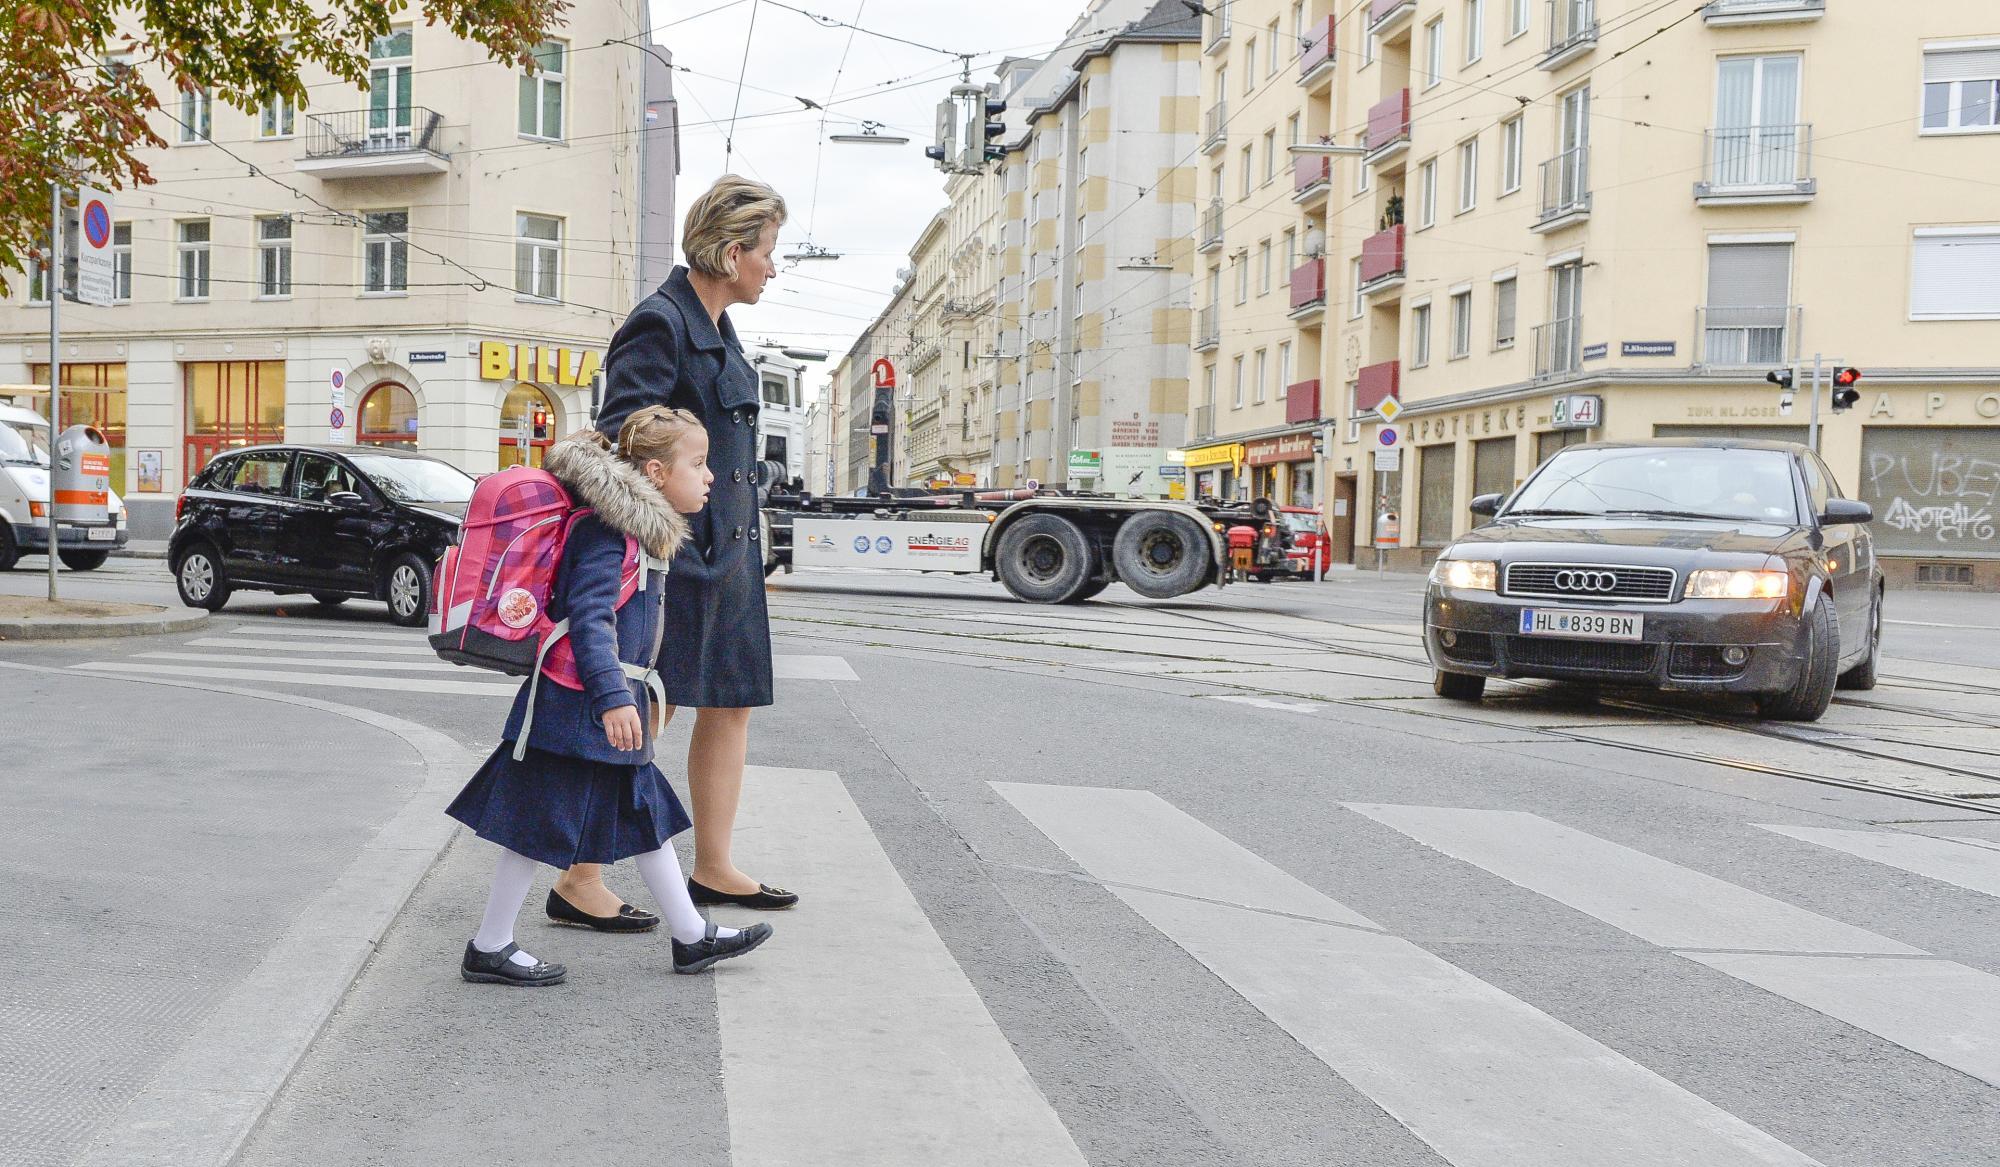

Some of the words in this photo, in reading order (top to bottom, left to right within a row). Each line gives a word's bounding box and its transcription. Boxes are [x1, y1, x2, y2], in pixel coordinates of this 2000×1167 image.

[480, 341, 600, 387] BILLA
[1405, 405, 1526, 443] APOTHEKE
[907, 535, 954, 546] ENERGIE
[954, 537, 969, 547] AG
[1536, 613, 1556, 631] HL
[1571, 615, 1605, 633] 839
[1610, 617, 1634, 635] BN
